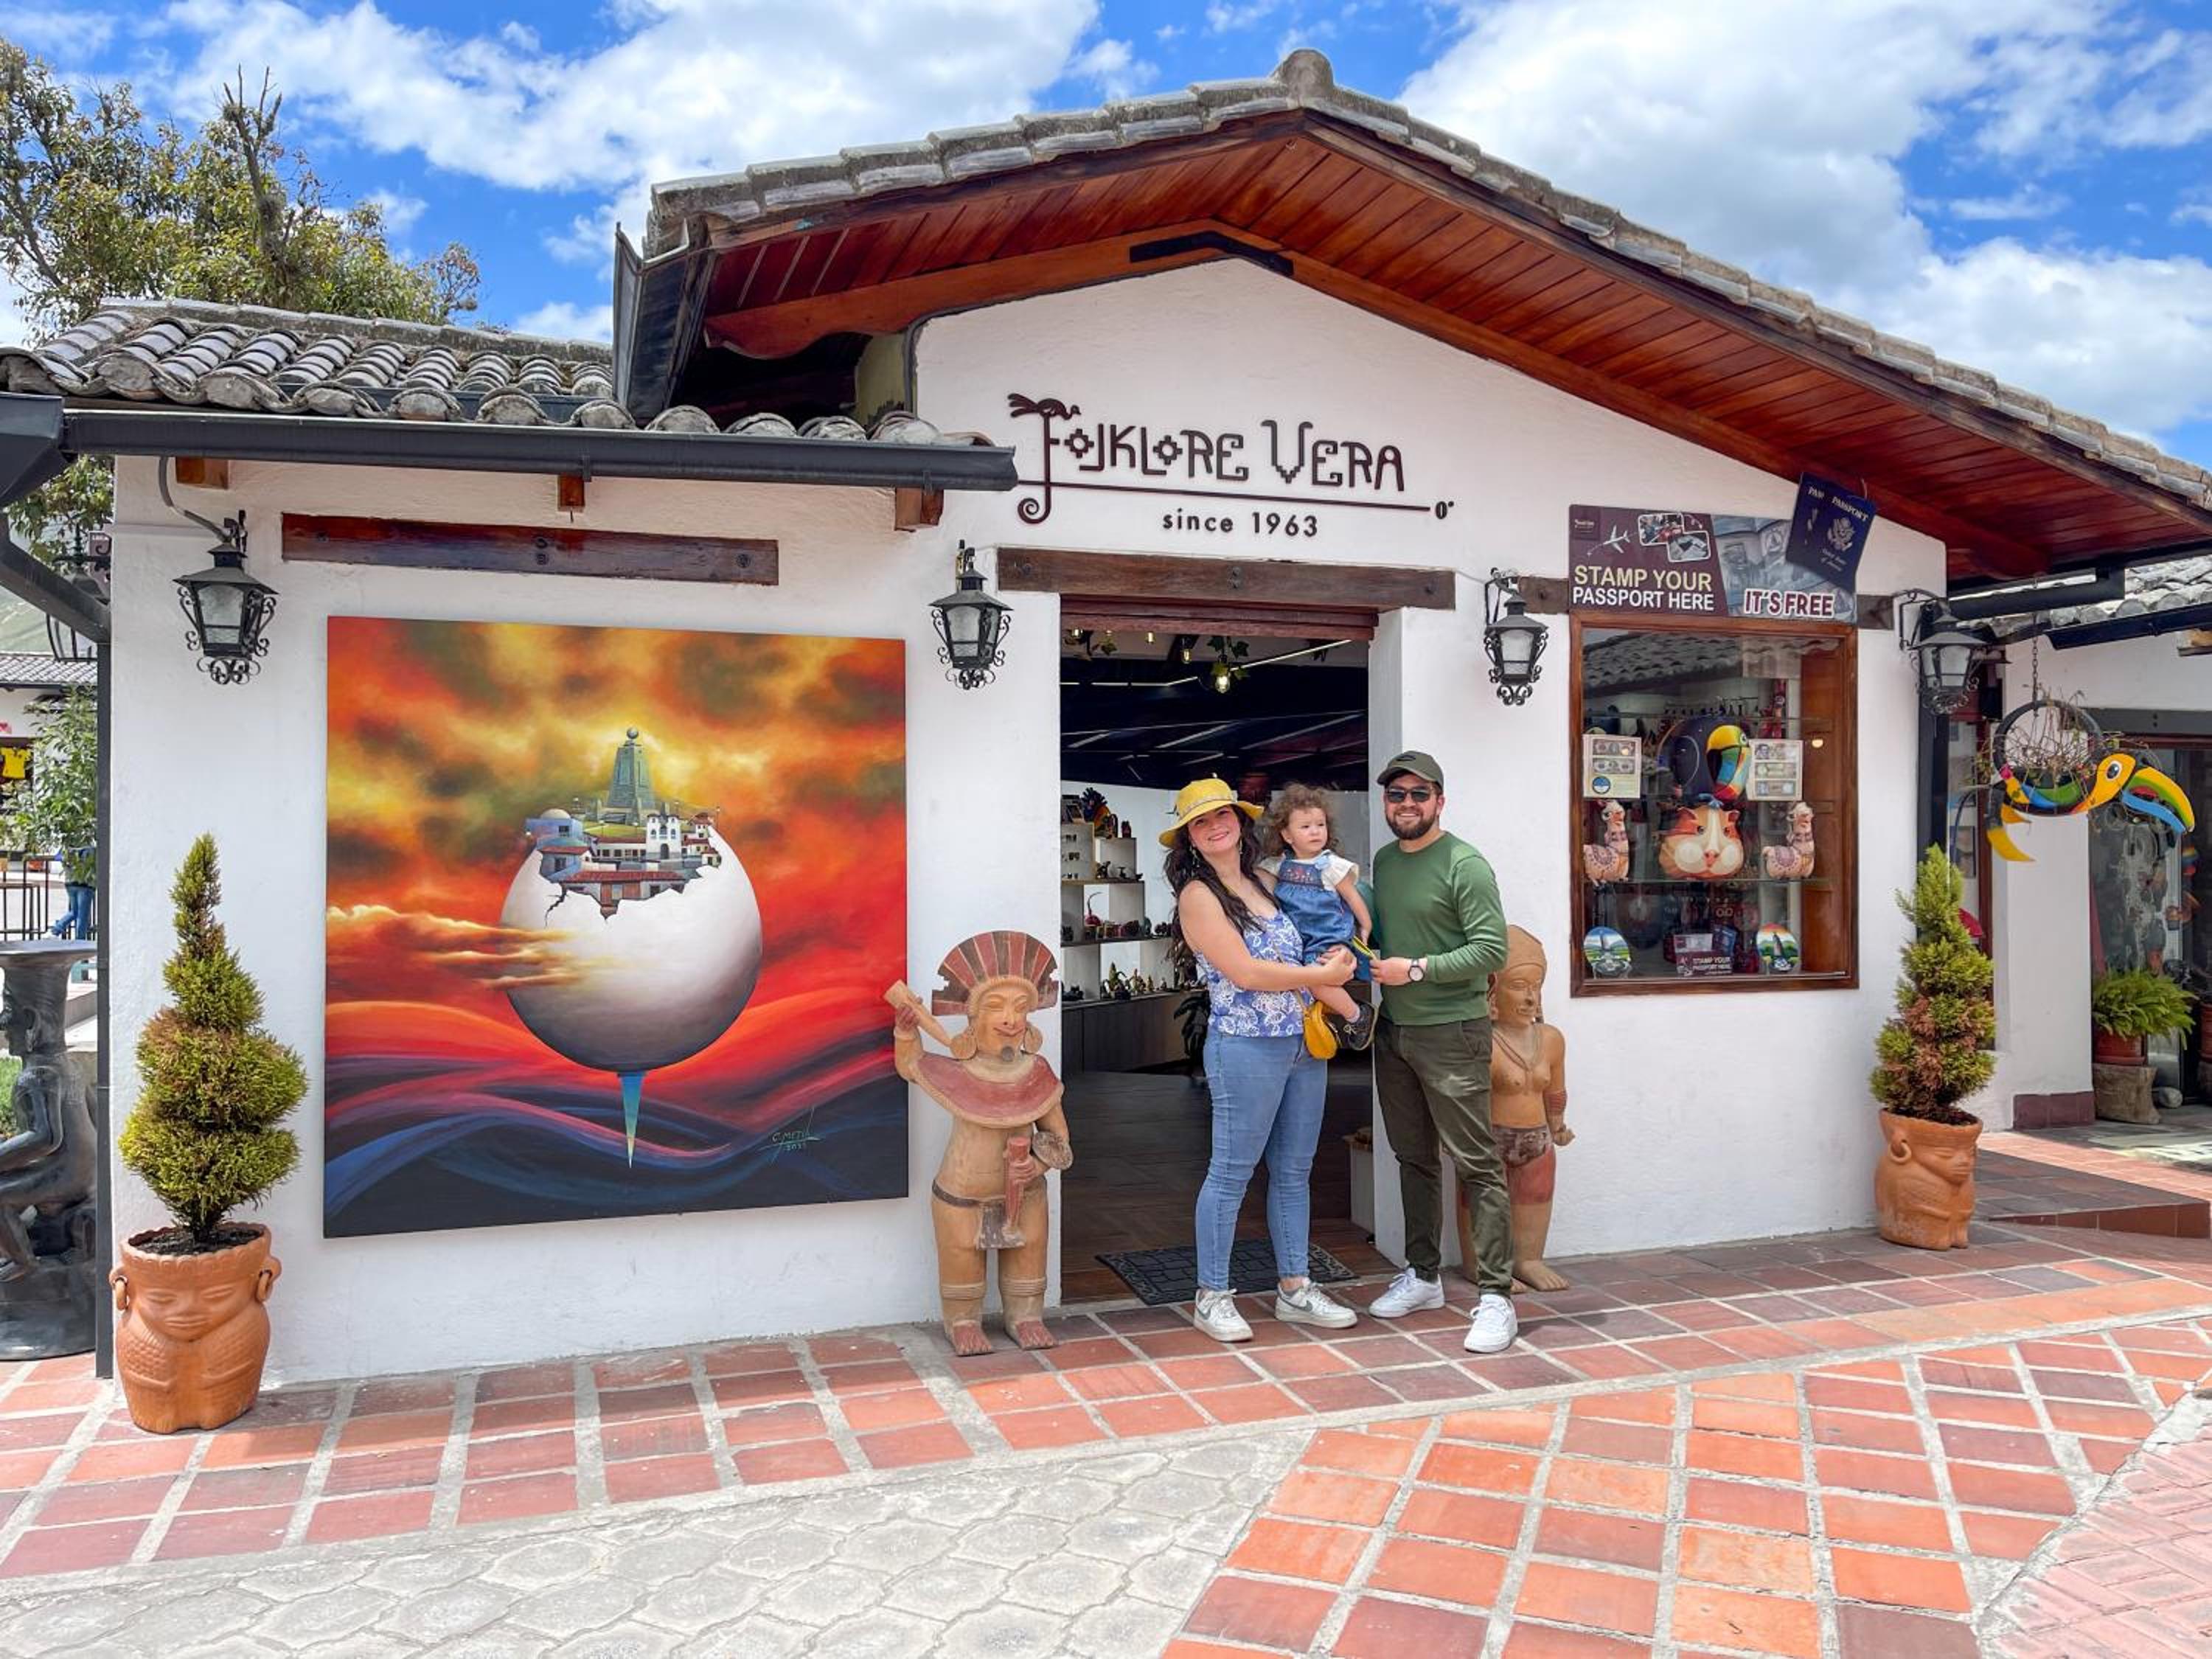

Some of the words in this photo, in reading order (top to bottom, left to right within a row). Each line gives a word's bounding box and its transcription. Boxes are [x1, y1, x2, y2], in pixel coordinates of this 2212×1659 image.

[1007, 393, 1249, 524] FOLKLORE
[1260, 420, 1405, 492] VERA
[1162, 507, 1234, 532] since
[1251, 512, 1318, 538] 1963
[1574, 565, 1648, 588] STAMP
[1652, 569, 1711, 592] YOUR
[1573, 586, 1663, 608] PASSPORT
[1668, 592, 1714, 611] HERE
[1745, 589, 1781, 614] IT'S
[1784, 592, 1834, 617] FREE
